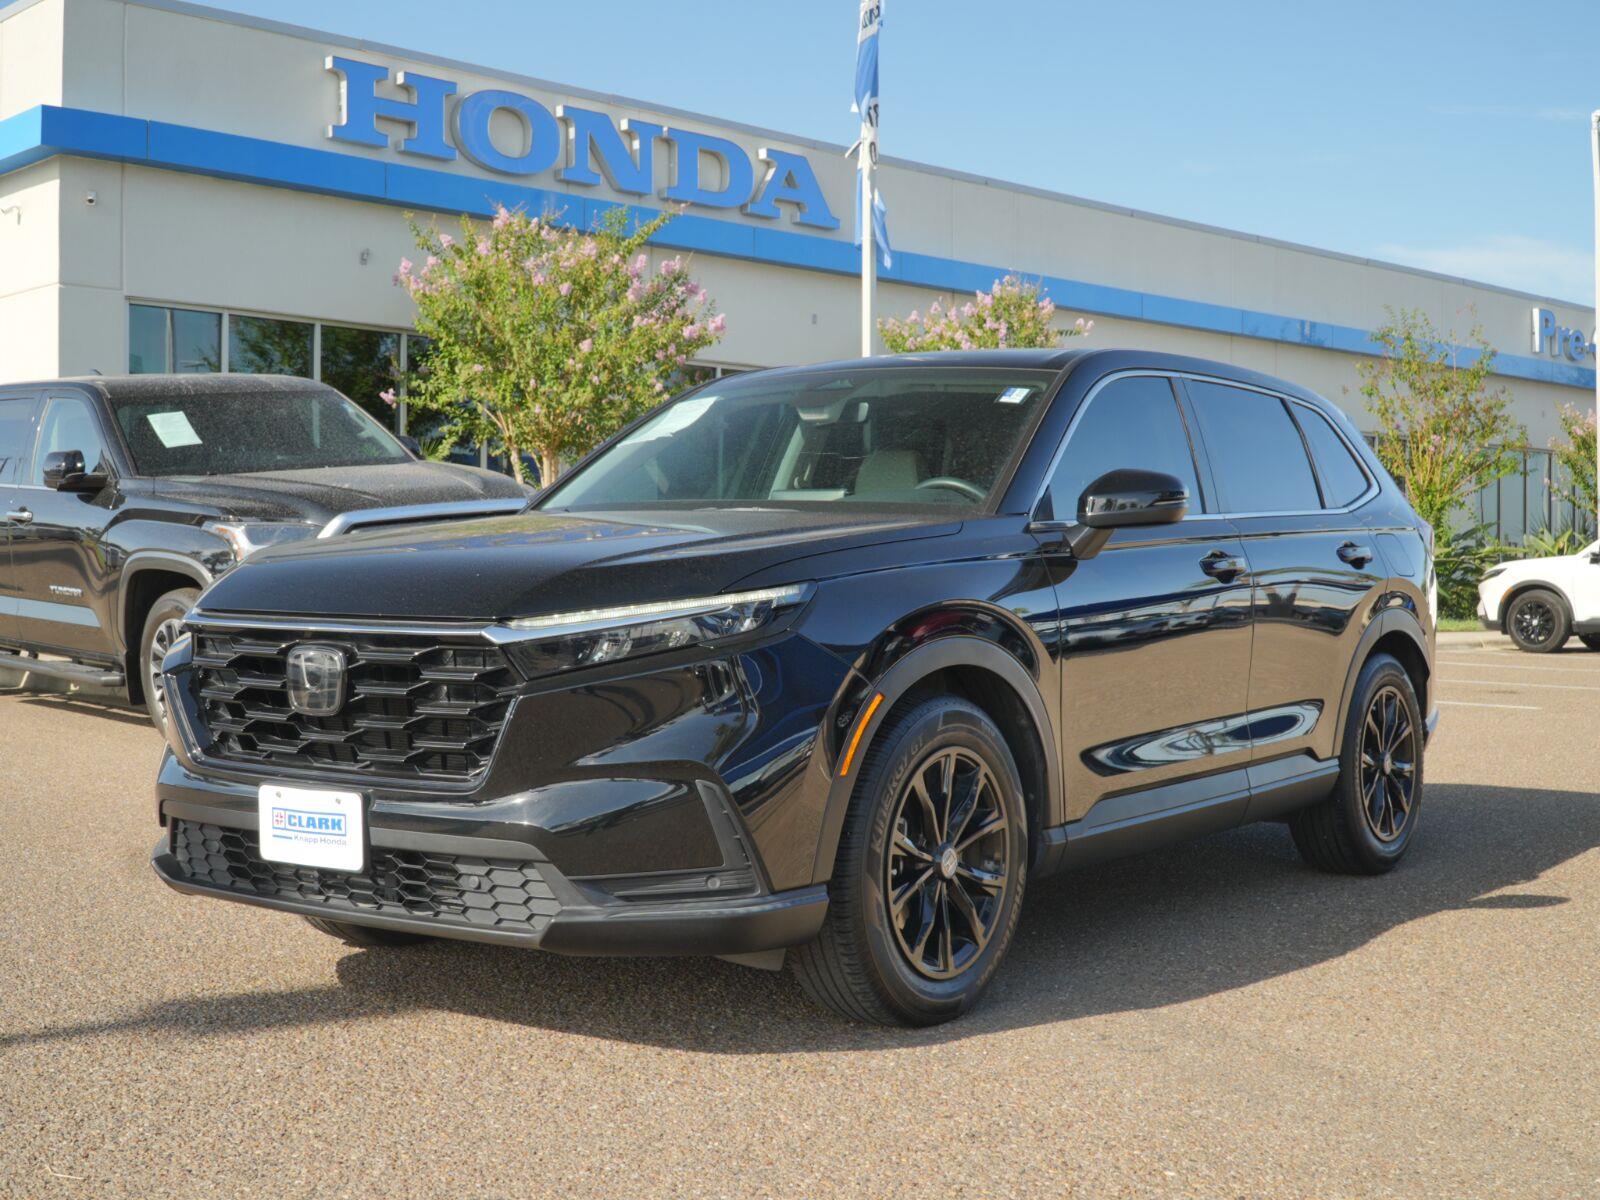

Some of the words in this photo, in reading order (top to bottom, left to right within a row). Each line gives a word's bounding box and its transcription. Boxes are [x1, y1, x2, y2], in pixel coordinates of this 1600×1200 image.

[326, 55, 840, 230] HONDA
[287, 814, 343, 831] CLARK
[294, 834, 319, 845] Knapp
[319, 836, 347, 847] Honda
